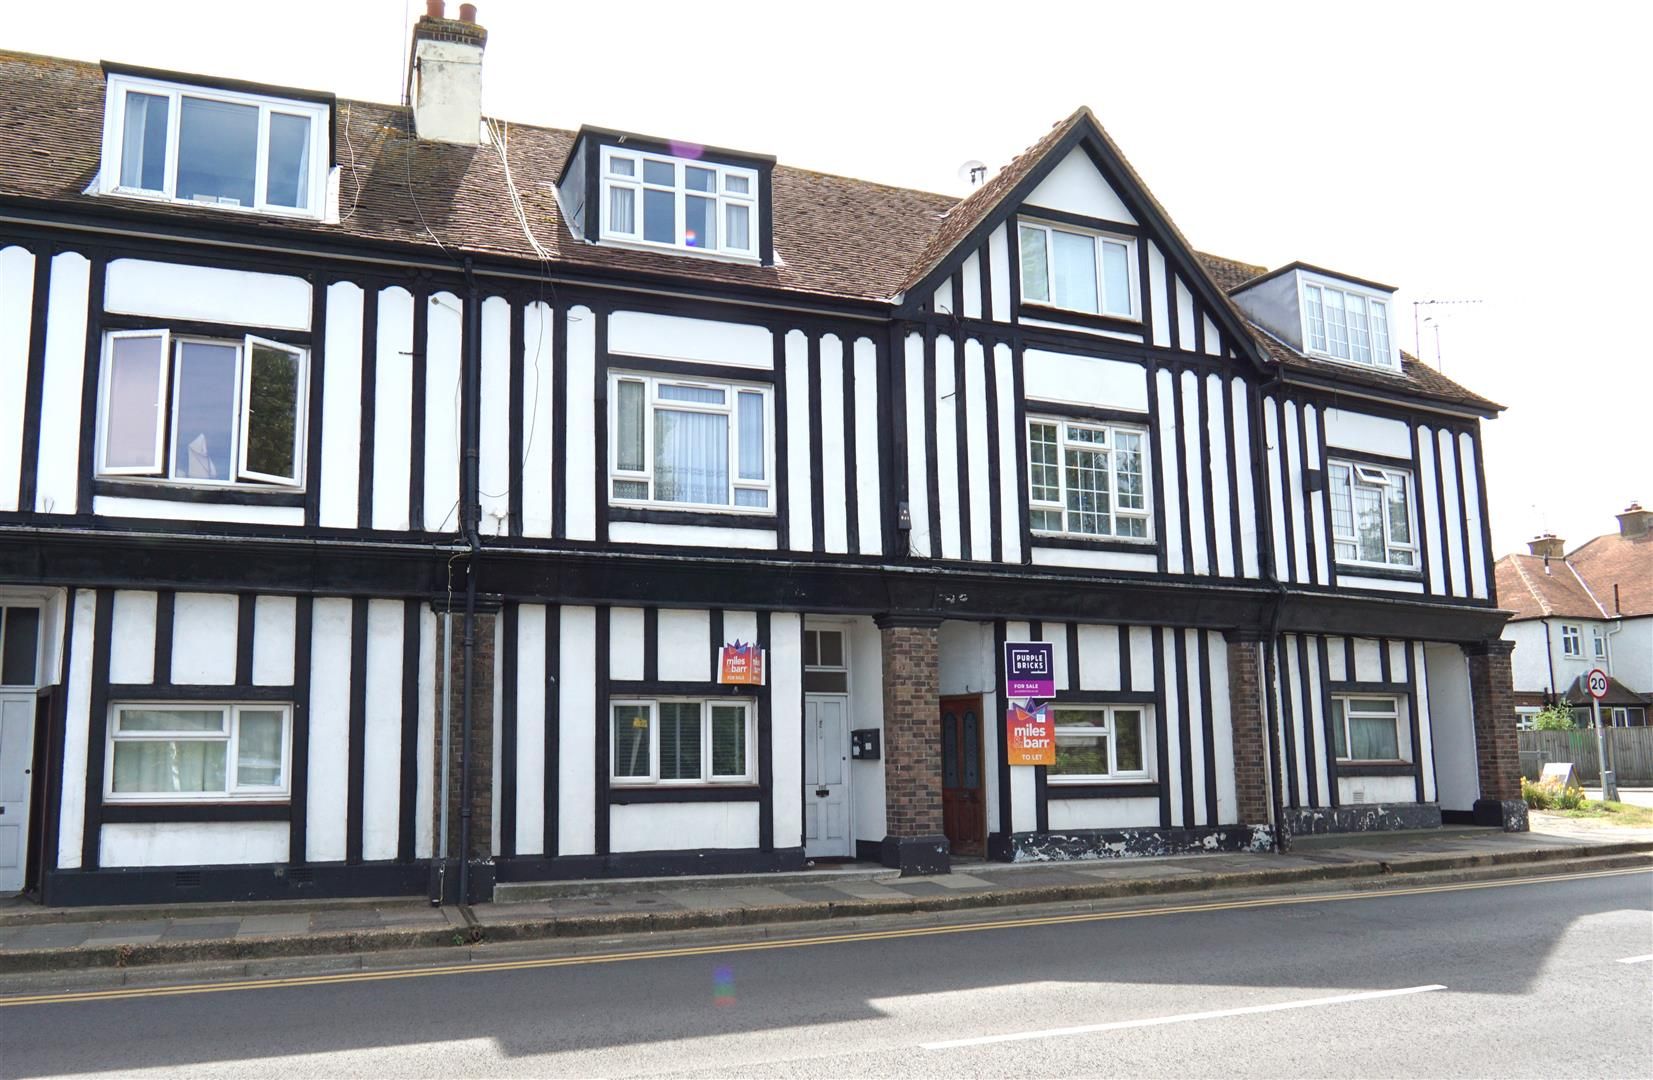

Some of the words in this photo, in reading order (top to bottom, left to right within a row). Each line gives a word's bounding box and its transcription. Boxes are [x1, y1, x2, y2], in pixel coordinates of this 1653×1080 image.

[727, 656, 746, 665] miles
[731, 665, 747, 673] barr
[1591, 678, 1605, 690] 20
[1014, 723, 1046, 737] miles
[1023, 736, 1050, 748] barr
[1022, 753, 1030, 761] TO
[1031, 753, 1043, 761] LET
